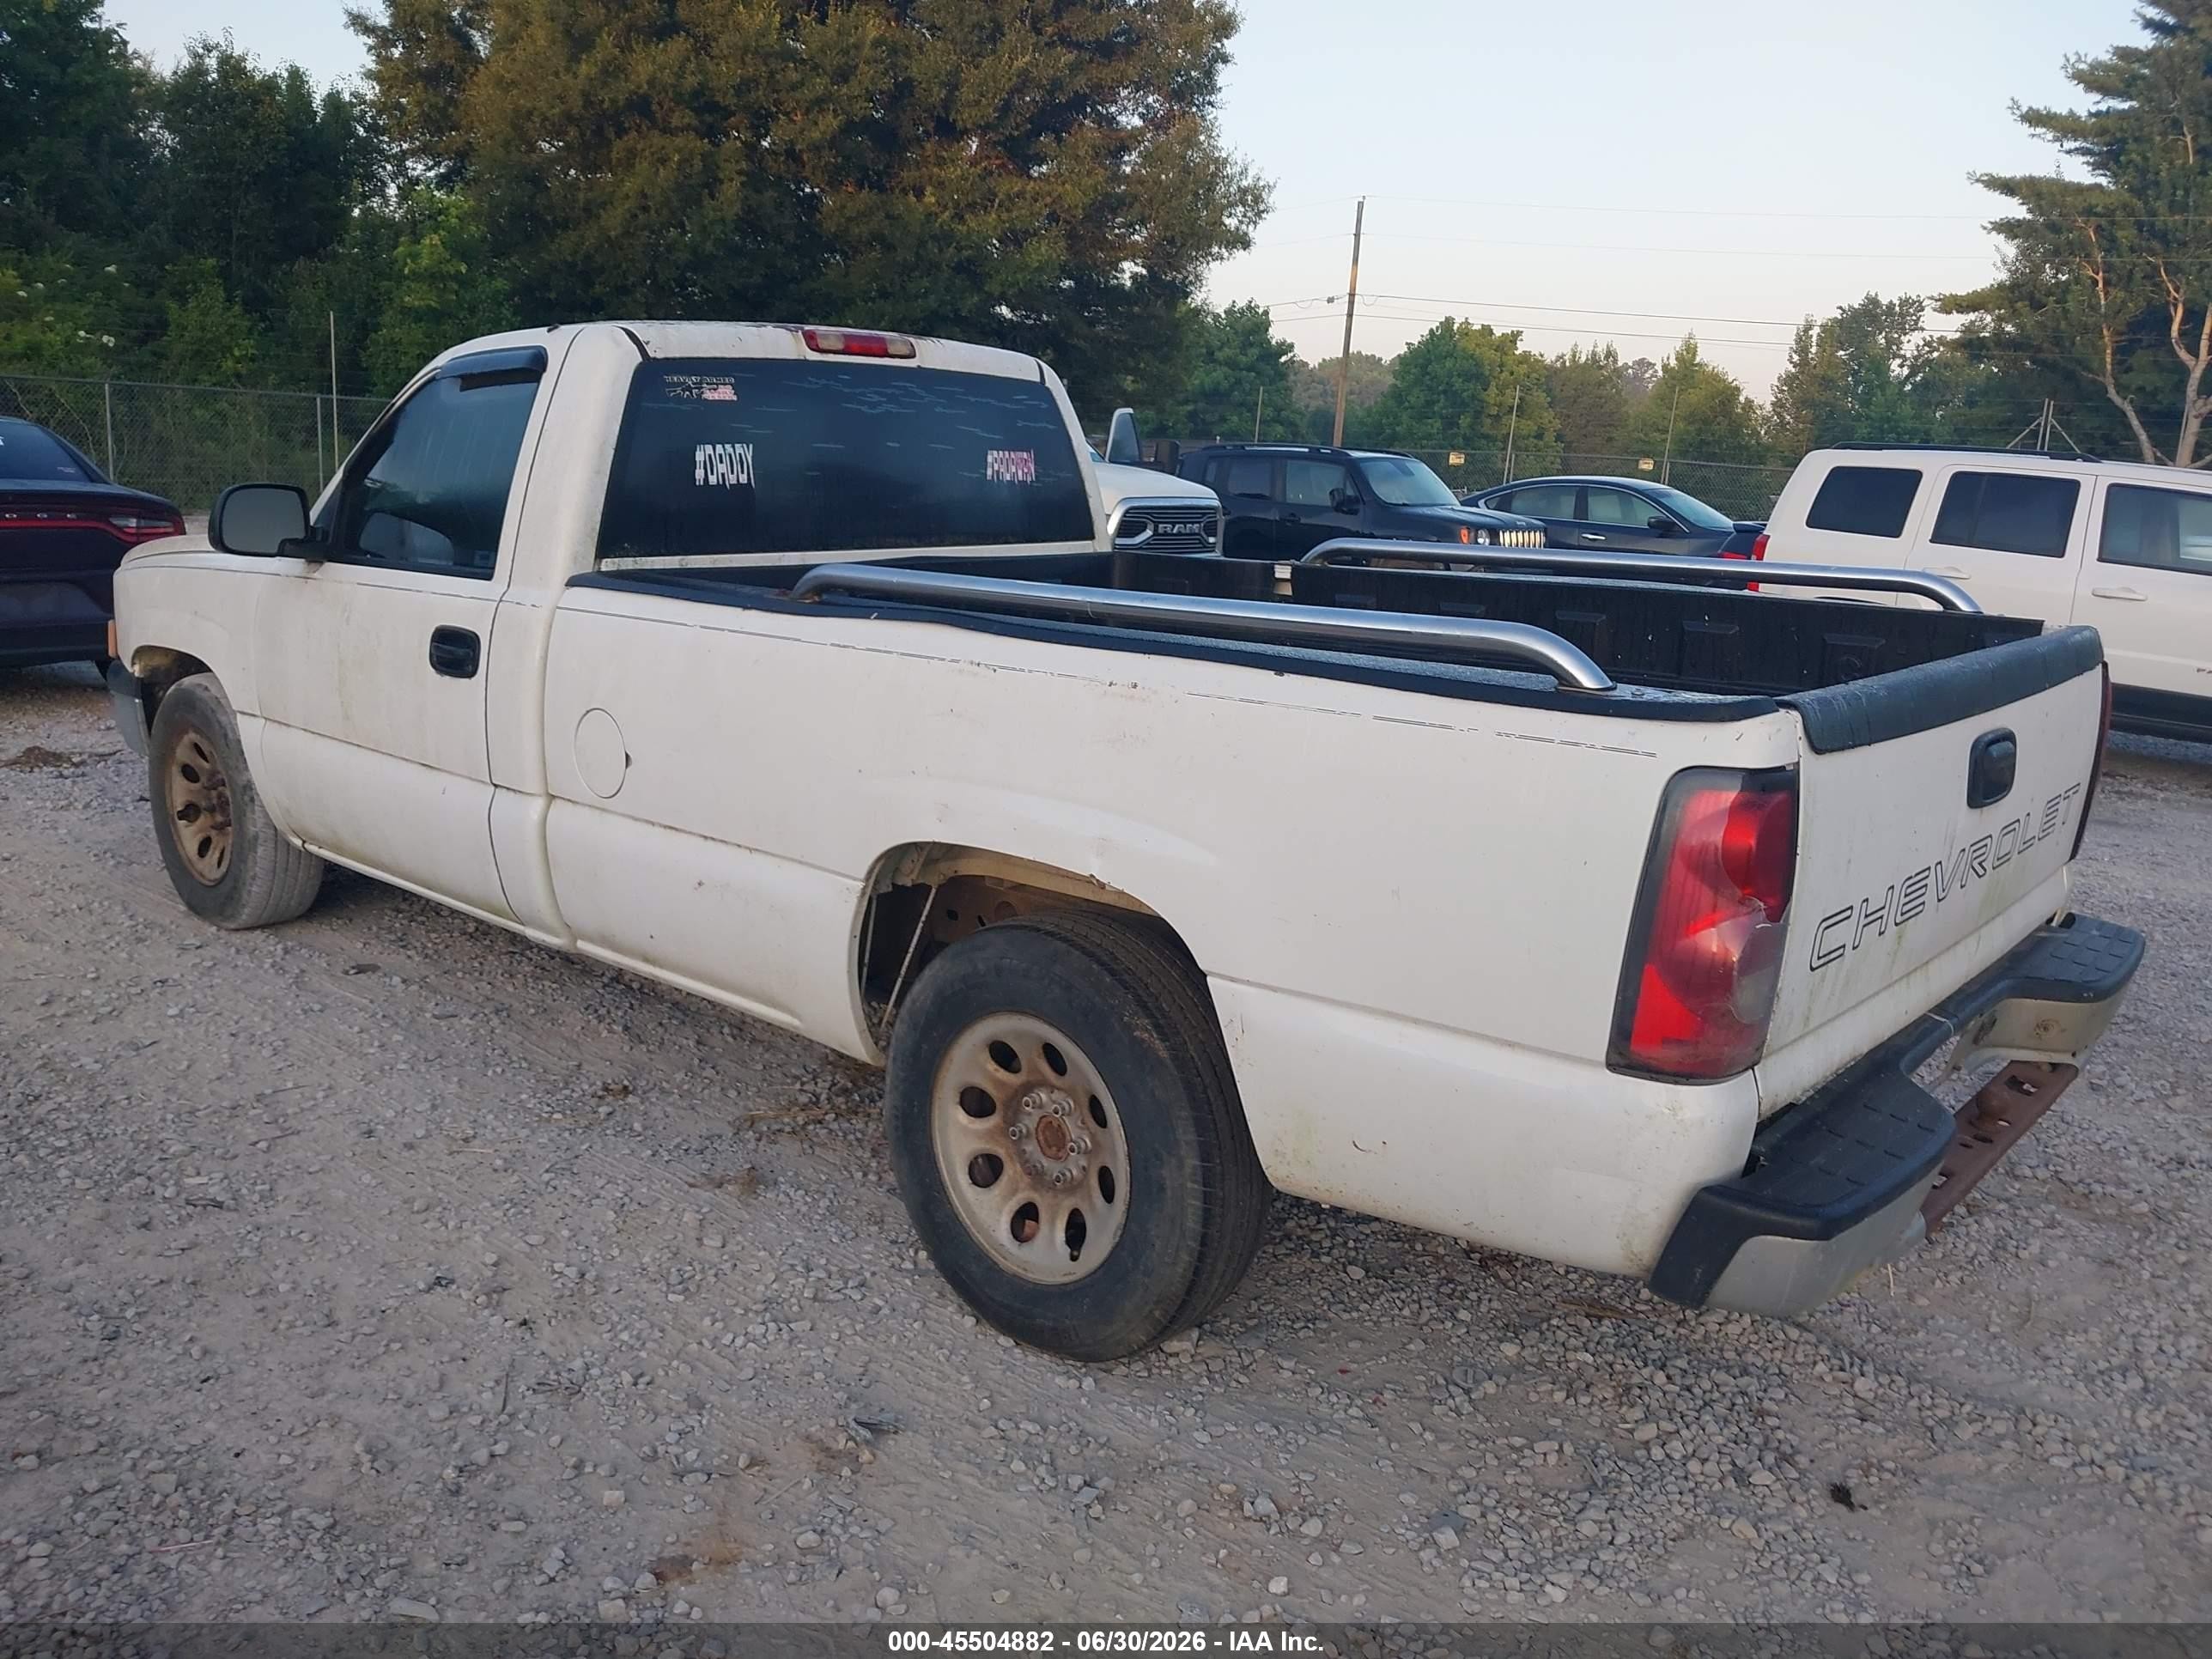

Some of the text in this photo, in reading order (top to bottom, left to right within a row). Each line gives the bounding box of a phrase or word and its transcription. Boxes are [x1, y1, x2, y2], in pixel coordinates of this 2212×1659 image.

[695, 443, 756, 490] #DADDY
[1158, 523, 1200, 533] RAM
[1809, 782, 2081, 972] CHEVROLET
